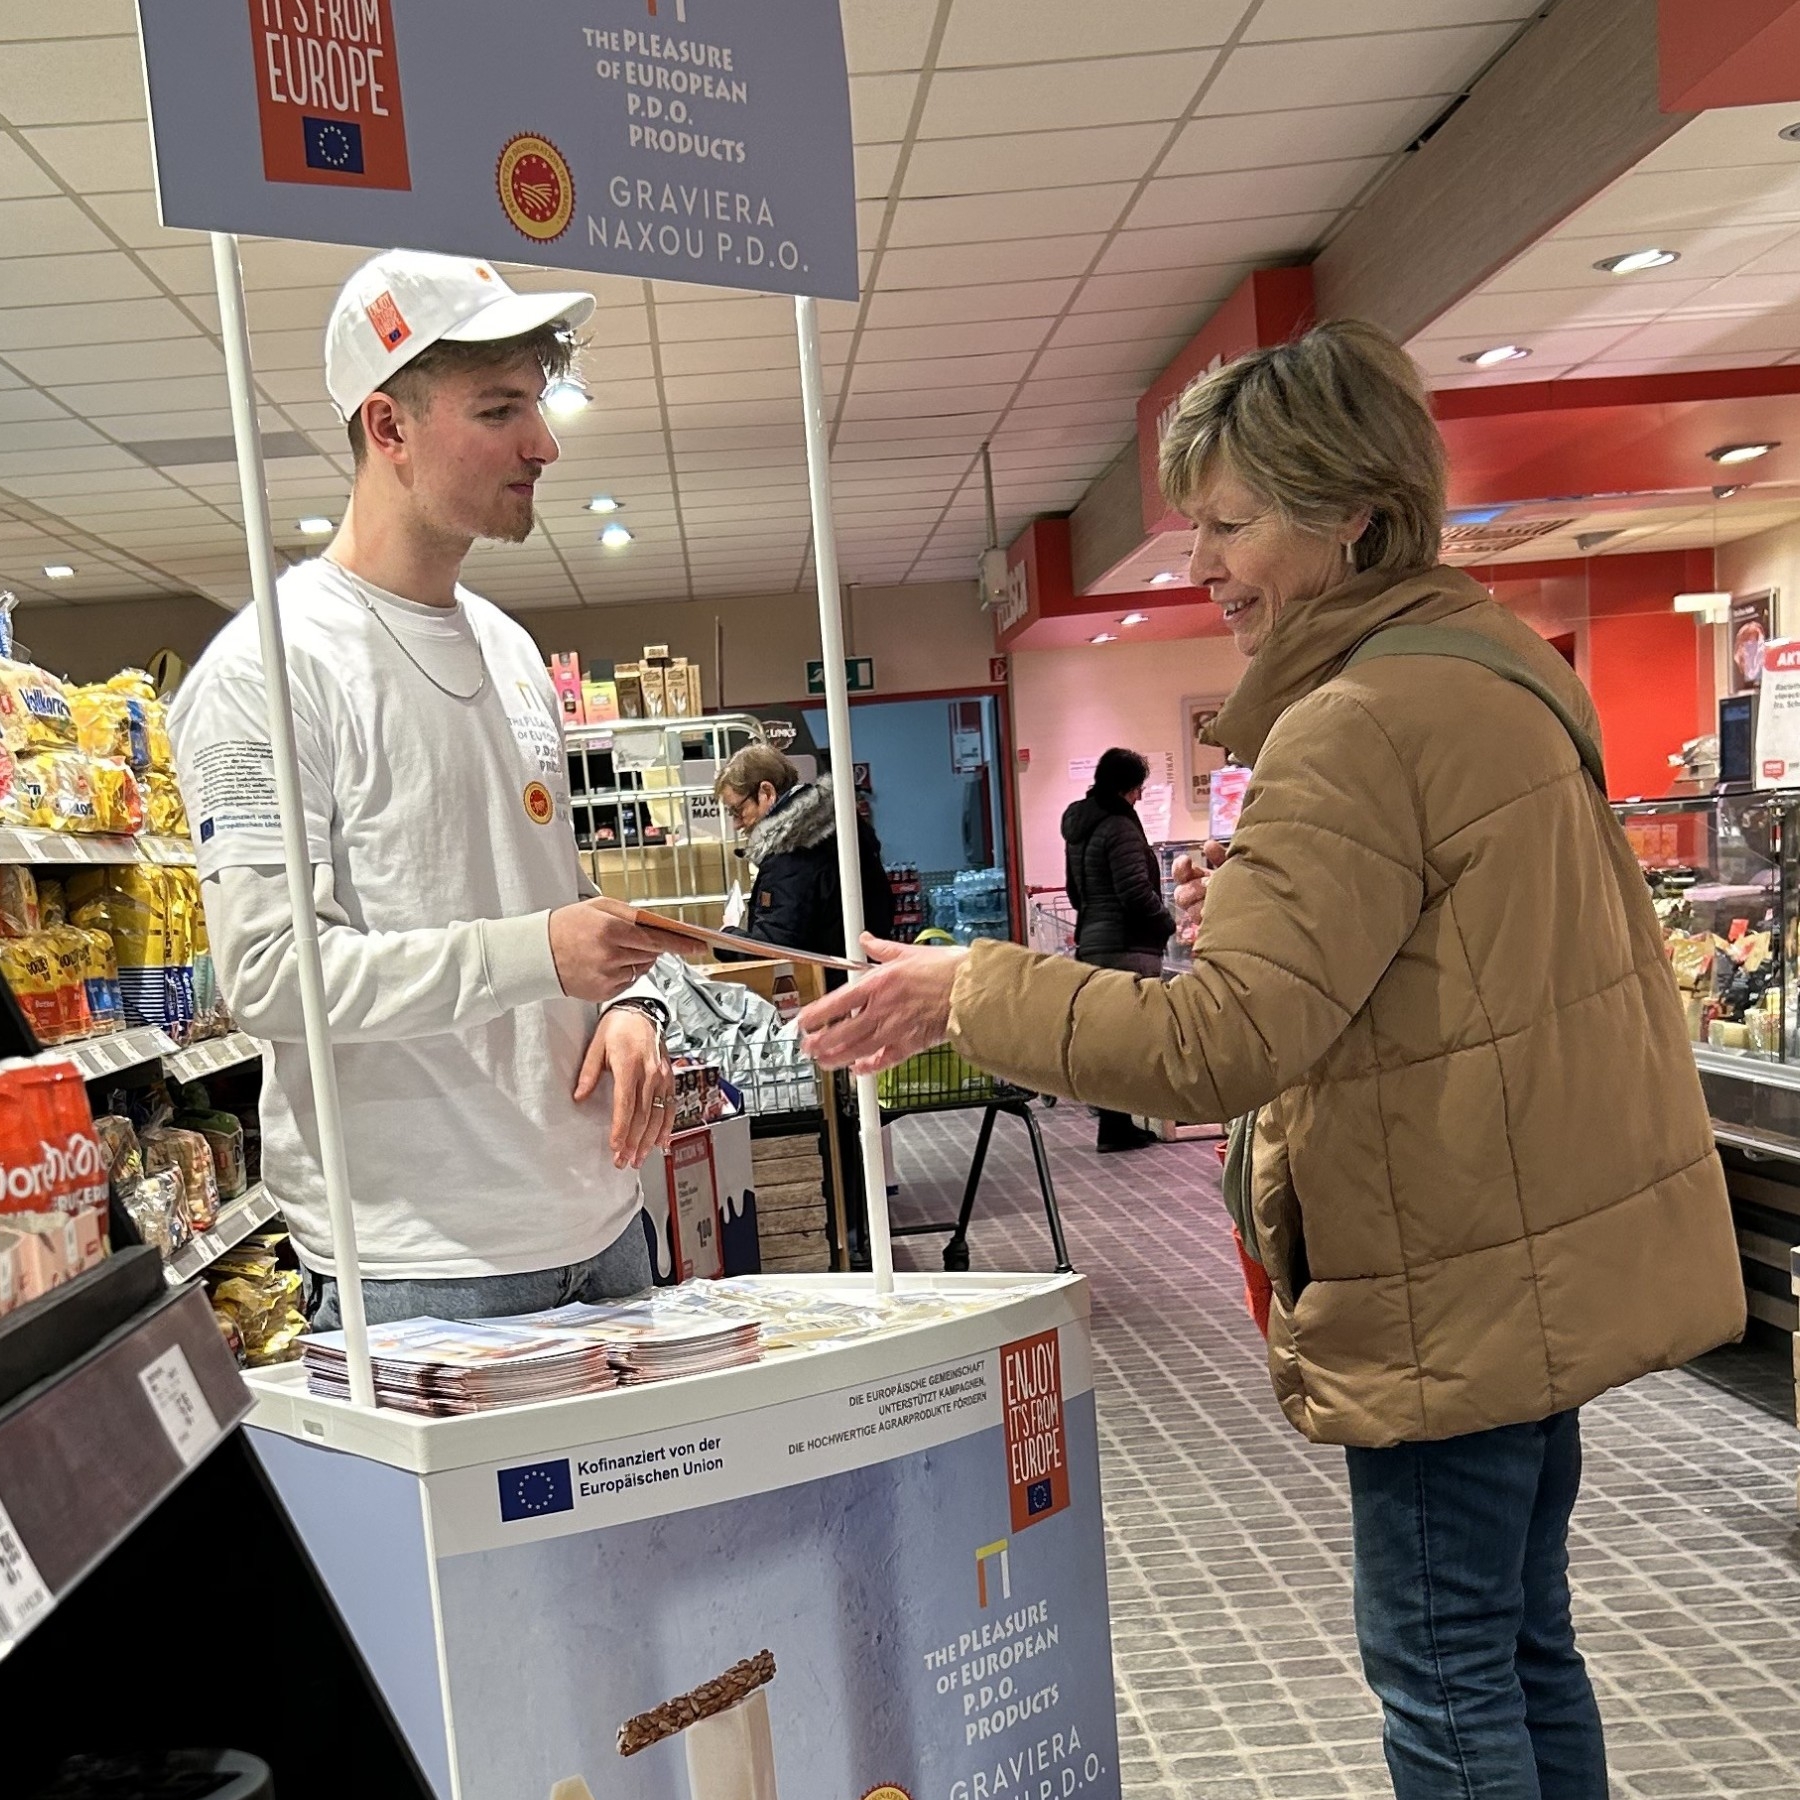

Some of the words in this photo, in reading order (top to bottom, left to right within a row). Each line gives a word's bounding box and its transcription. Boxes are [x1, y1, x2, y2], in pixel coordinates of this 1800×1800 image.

[262, 0, 309, 34] ITS
[314, 0, 382, 45] FROM
[582, 27, 620, 51] THE
[623, 29, 734, 72] PLEASURE
[265, 31, 389, 117] EUROPE
[596, 59, 621, 80] OF
[625, 61, 747, 104] EUROPEAN
[627, 92, 693, 125] P.D.O.
[629, 124, 746, 163] PRODUCTS
[609, 175, 774, 227] GRAVIERA
[587, 214, 704, 259] NAXOU
[717, 232, 809, 273] P.D.O.
[1776, 651, 1800, 667] AKT
[848, 1393, 865, 1407] DIE
[866, 1377, 927, 1403] EUROPÄISCHE
[928, 1360, 985, 1386] GEMEINSCHAFT
[1005, 1341, 1055, 1406] ENJOY
[788, 1442, 804, 1455] DIE
[807, 1424, 876, 1451] HOCHWERTIGE
[878, 1403, 951, 1433] AGRARPRODUKTE
[953, 1391, 987, 1410] FÖRDERN
[878, 1390, 937, 1416] UNTERSTÜTZT
[1008, 1403, 1030, 1442] IT'S
[1031, 1391, 1059, 1435] FROM
[578, 1447, 666, 1476] Kofinanziert
[669, 1443, 695, 1457] von
[699, 1437, 721, 1451] der
[580, 1468, 679, 1497] Europäischen
[683, 1458, 724, 1475] Union
[1011, 1428, 1062, 1485] EUROPE
[923, 1643, 957, 1671] THE
[959, 1599, 1048, 1657] PLEASURE
[936, 1671, 958, 1694] OF
[961, 1624, 1059, 1687] EUROPEAN
[963, 1676, 1018, 1716] P.D.O.
[965, 1682, 1059, 1746] PRODUCTS
[950, 1724, 1081, 1800] GRAVIERA
[1040, 1753, 1106, 1800] P.D.O.
